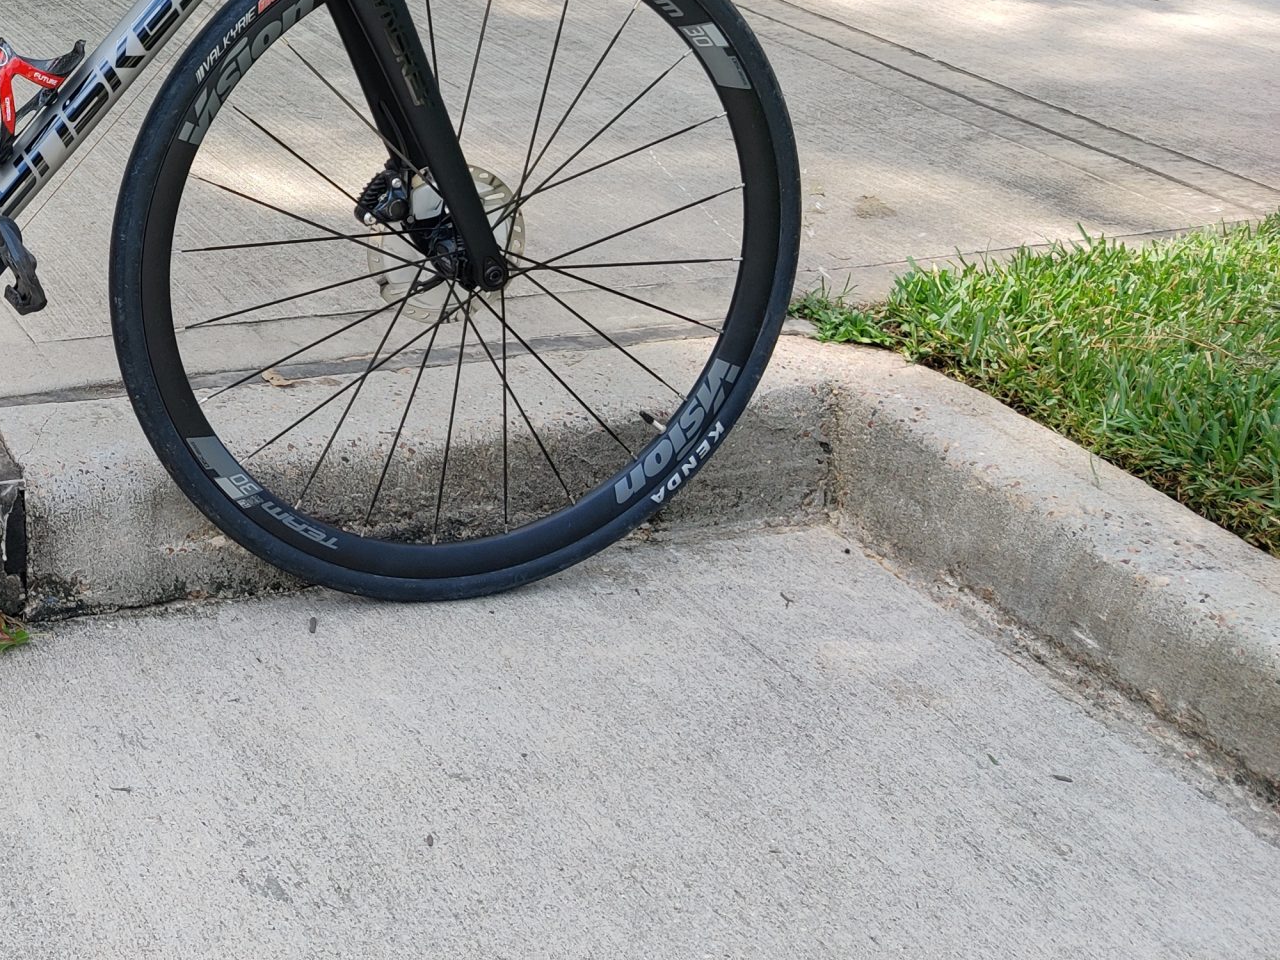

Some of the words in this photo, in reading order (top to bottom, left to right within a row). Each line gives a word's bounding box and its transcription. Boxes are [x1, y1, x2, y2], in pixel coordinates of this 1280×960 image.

[203, 6, 257, 72] VALKYRIE
[683, 26, 714, 48] 30
[230, 474, 260, 496] 30
[651, 421, 725, 504] KENDA
[261, 501, 339, 550] TEAM
